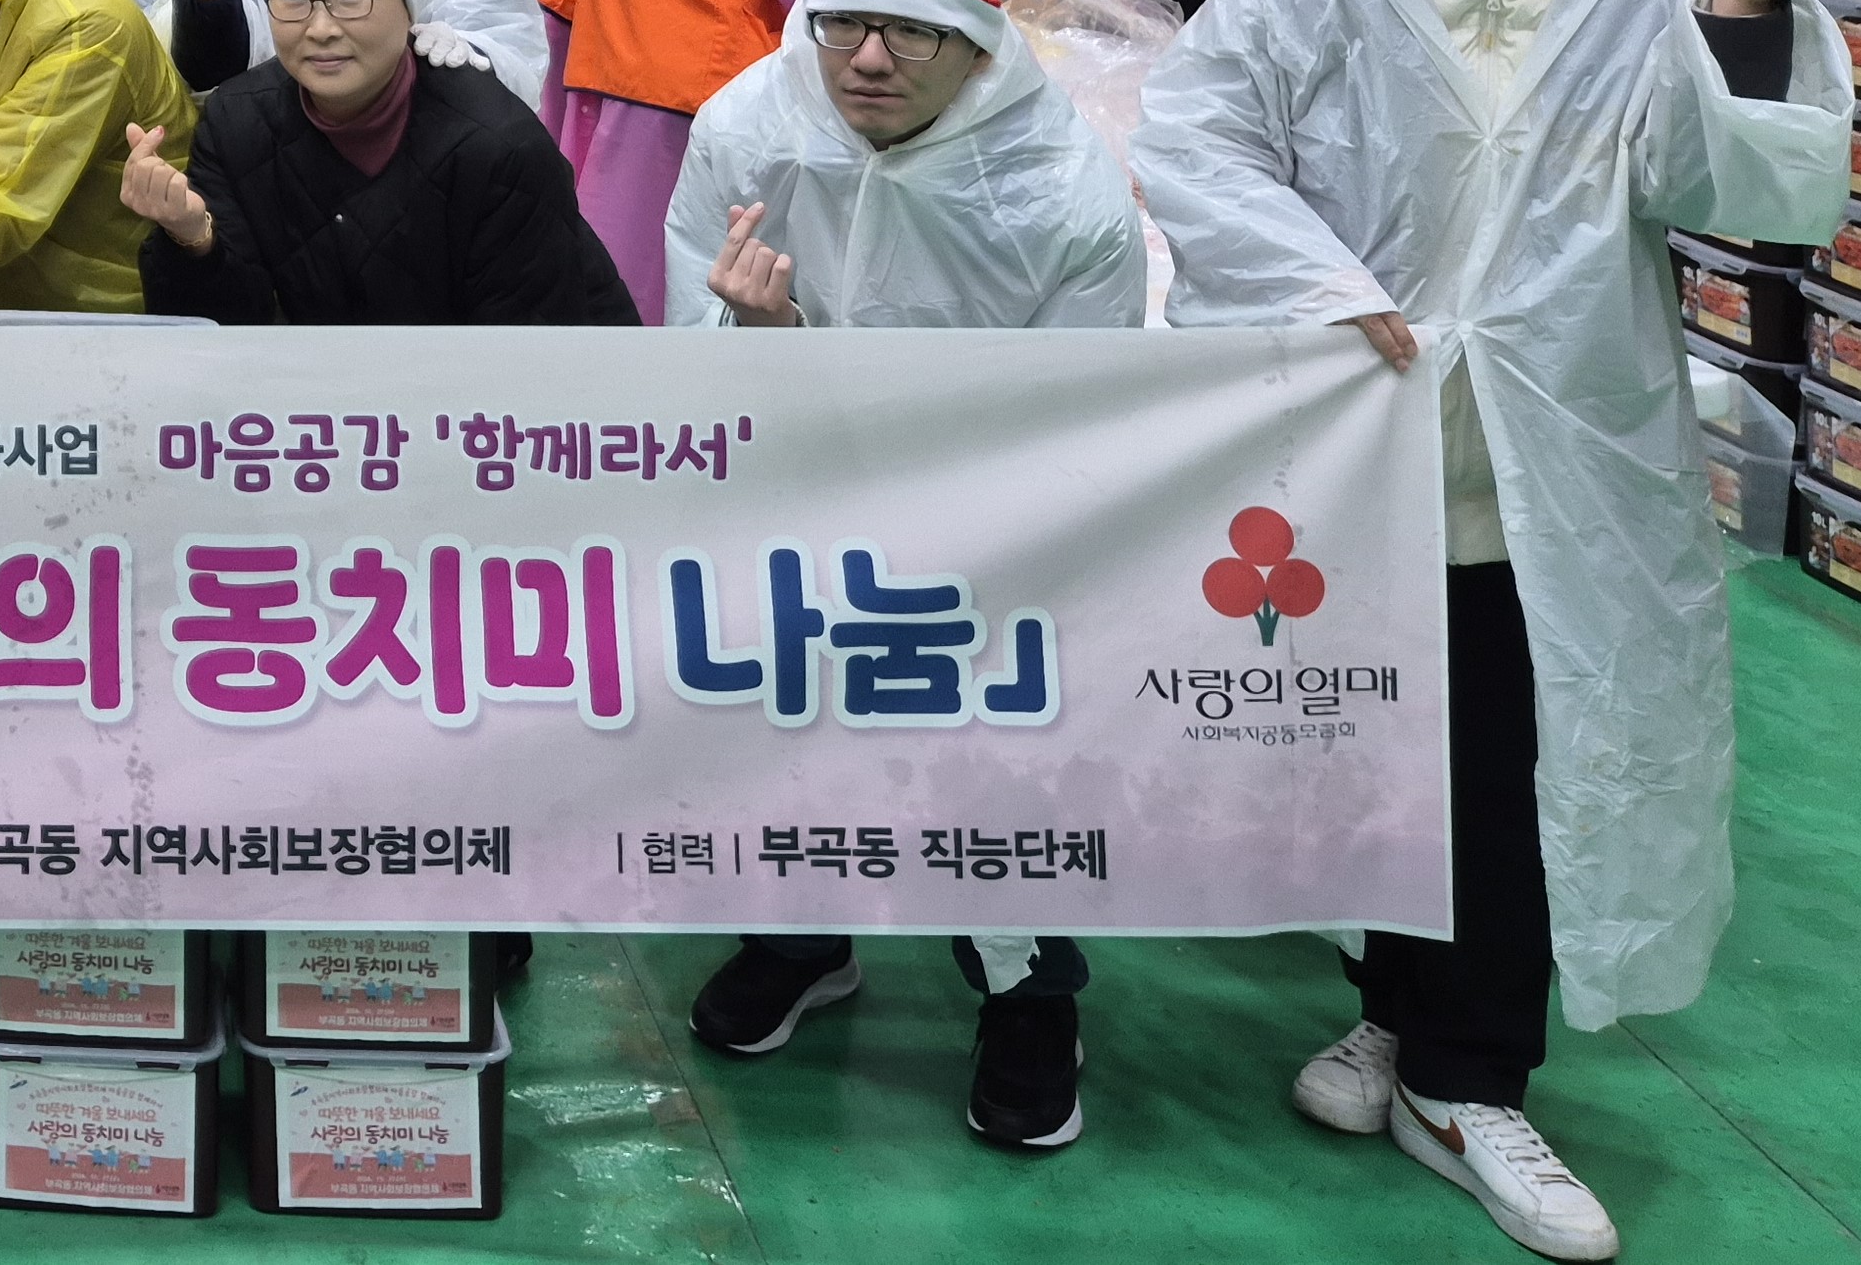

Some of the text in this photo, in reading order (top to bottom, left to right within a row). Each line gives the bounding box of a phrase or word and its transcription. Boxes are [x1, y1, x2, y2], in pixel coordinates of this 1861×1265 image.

[157, 412, 410, 494] 마음공감
[170, 543, 624, 718] 동치미
[1181, 720, 1358, 747] 사회복지공동모금회
[100, 824, 512, 877] 지역사회보장협의체
[758, 824, 900, 879] 부곡동
[920, 827, 1109, 881] 직능단체
